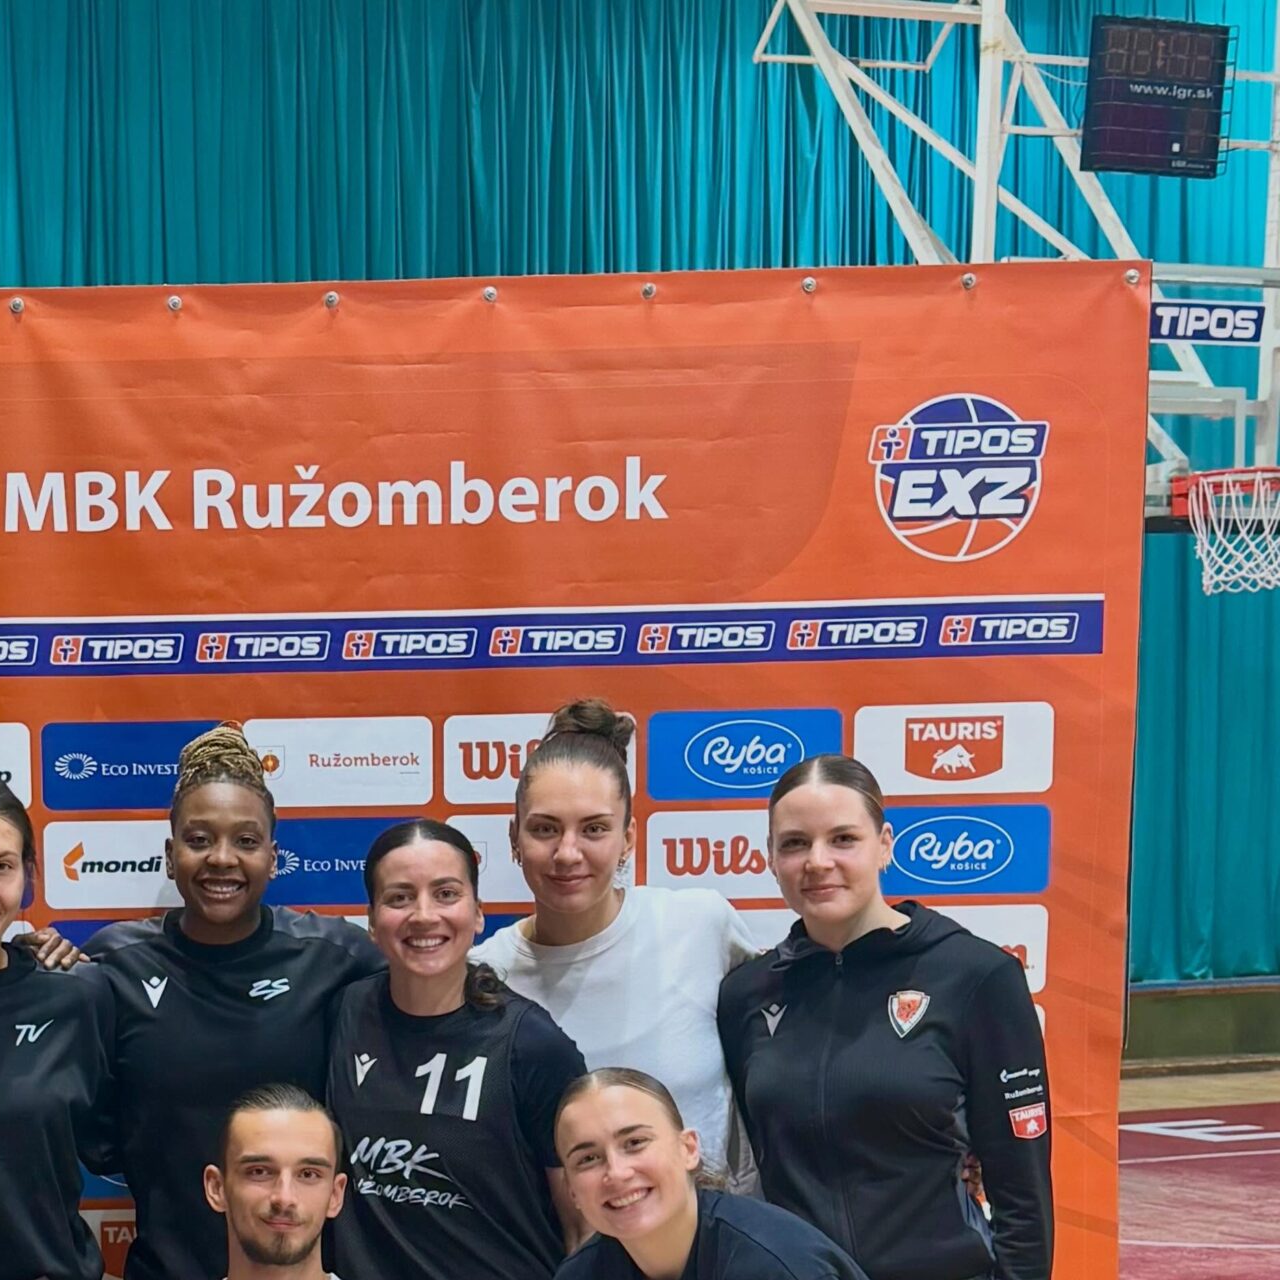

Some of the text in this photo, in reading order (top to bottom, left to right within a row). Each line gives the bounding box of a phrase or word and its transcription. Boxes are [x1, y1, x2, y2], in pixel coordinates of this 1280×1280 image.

[1129, 83, 1214, 100] www.igr.sk
[1155, 306, 1259, 340] TIPOS
[919, 427, 1039, 456] TIPOS
[4, 455, 669, 533] MBK Ružomberok
[892, 468, 1031, 517] EXZ
[87, 637, 177, 661] TIPOS
[233, 635, 323, 659] TIPOS
[379, 632, 469, 656] TIPOS
[527, 629, 617, 654] TIPOS
[675, 627, 767, 651] TIPOS
[826, 623, 919, 648] TIPOS
[978, 618, 1070, 643] TIPOS
[908, 721, 998, 741] TAURIS
[309, 752, 420, 768] Ružomberok
[703, 735, 786, 775] Ryba
[743, 763, 779, 775] KOŠICE
[81, 855, 163, 874] mondi
[662, 835, 767, 877] Wils
[910, 831, 995, 870] Ryba
[950, 860, 987, 871] KOŠICE
[415, 1053, 488, 1121] 11
[350, 1136, 454, 1184] MBK
